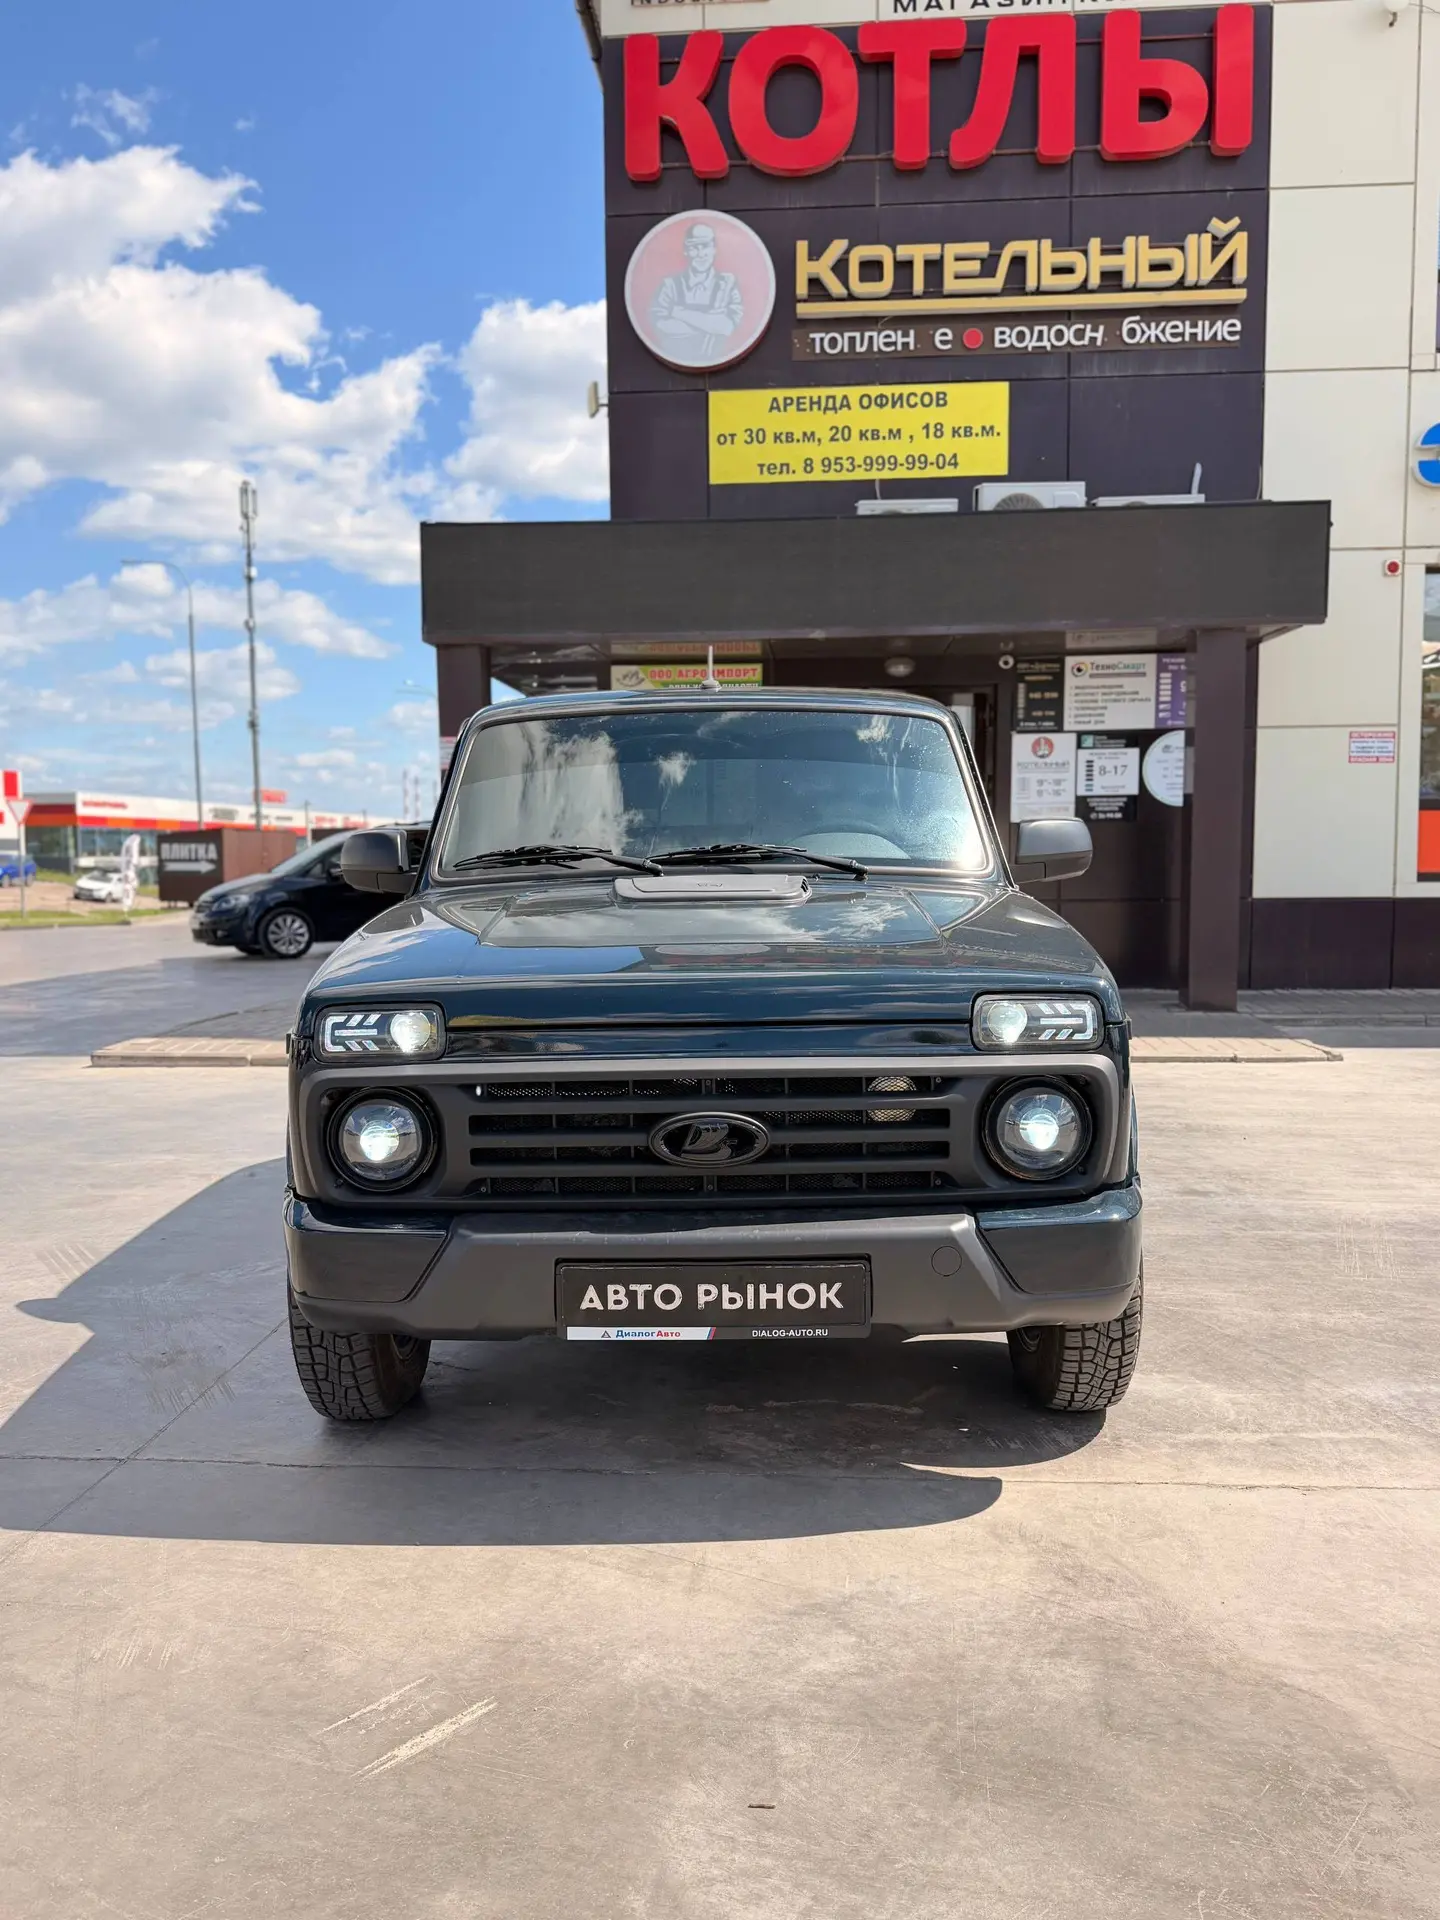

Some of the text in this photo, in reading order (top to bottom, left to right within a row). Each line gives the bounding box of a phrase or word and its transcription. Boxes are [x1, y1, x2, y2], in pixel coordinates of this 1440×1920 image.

[624, 4, 1255, 181] КОТЛЫ
[768, 391, 948, 414] АРЕНДА ОФИСОВ
[717, 432, 737, 445] от
[743, 428, 766, 445] 30
[828, 425, 852, 442] 20
[922, 422, 944, 439] 18
[951, 425, 1001, 439] кв.м.
[757, 453, 959, 476] тел. 8 953-999-99-04
[677, 668, 758, 679] АГРОМПОРТ
[1089, 662, 1146, 673] ТехноСмарт
[1099, 765, 1128, 776] 8-17
[161, 843, 218, 860] ПЛИТКА
[580, 1282, 844, 1311] АВТО РЫНОК
[615, 1329, 681, 1339] ДиалогАвто
[752, 1328, 829, 1338] DIALOG-AUTO.RU
